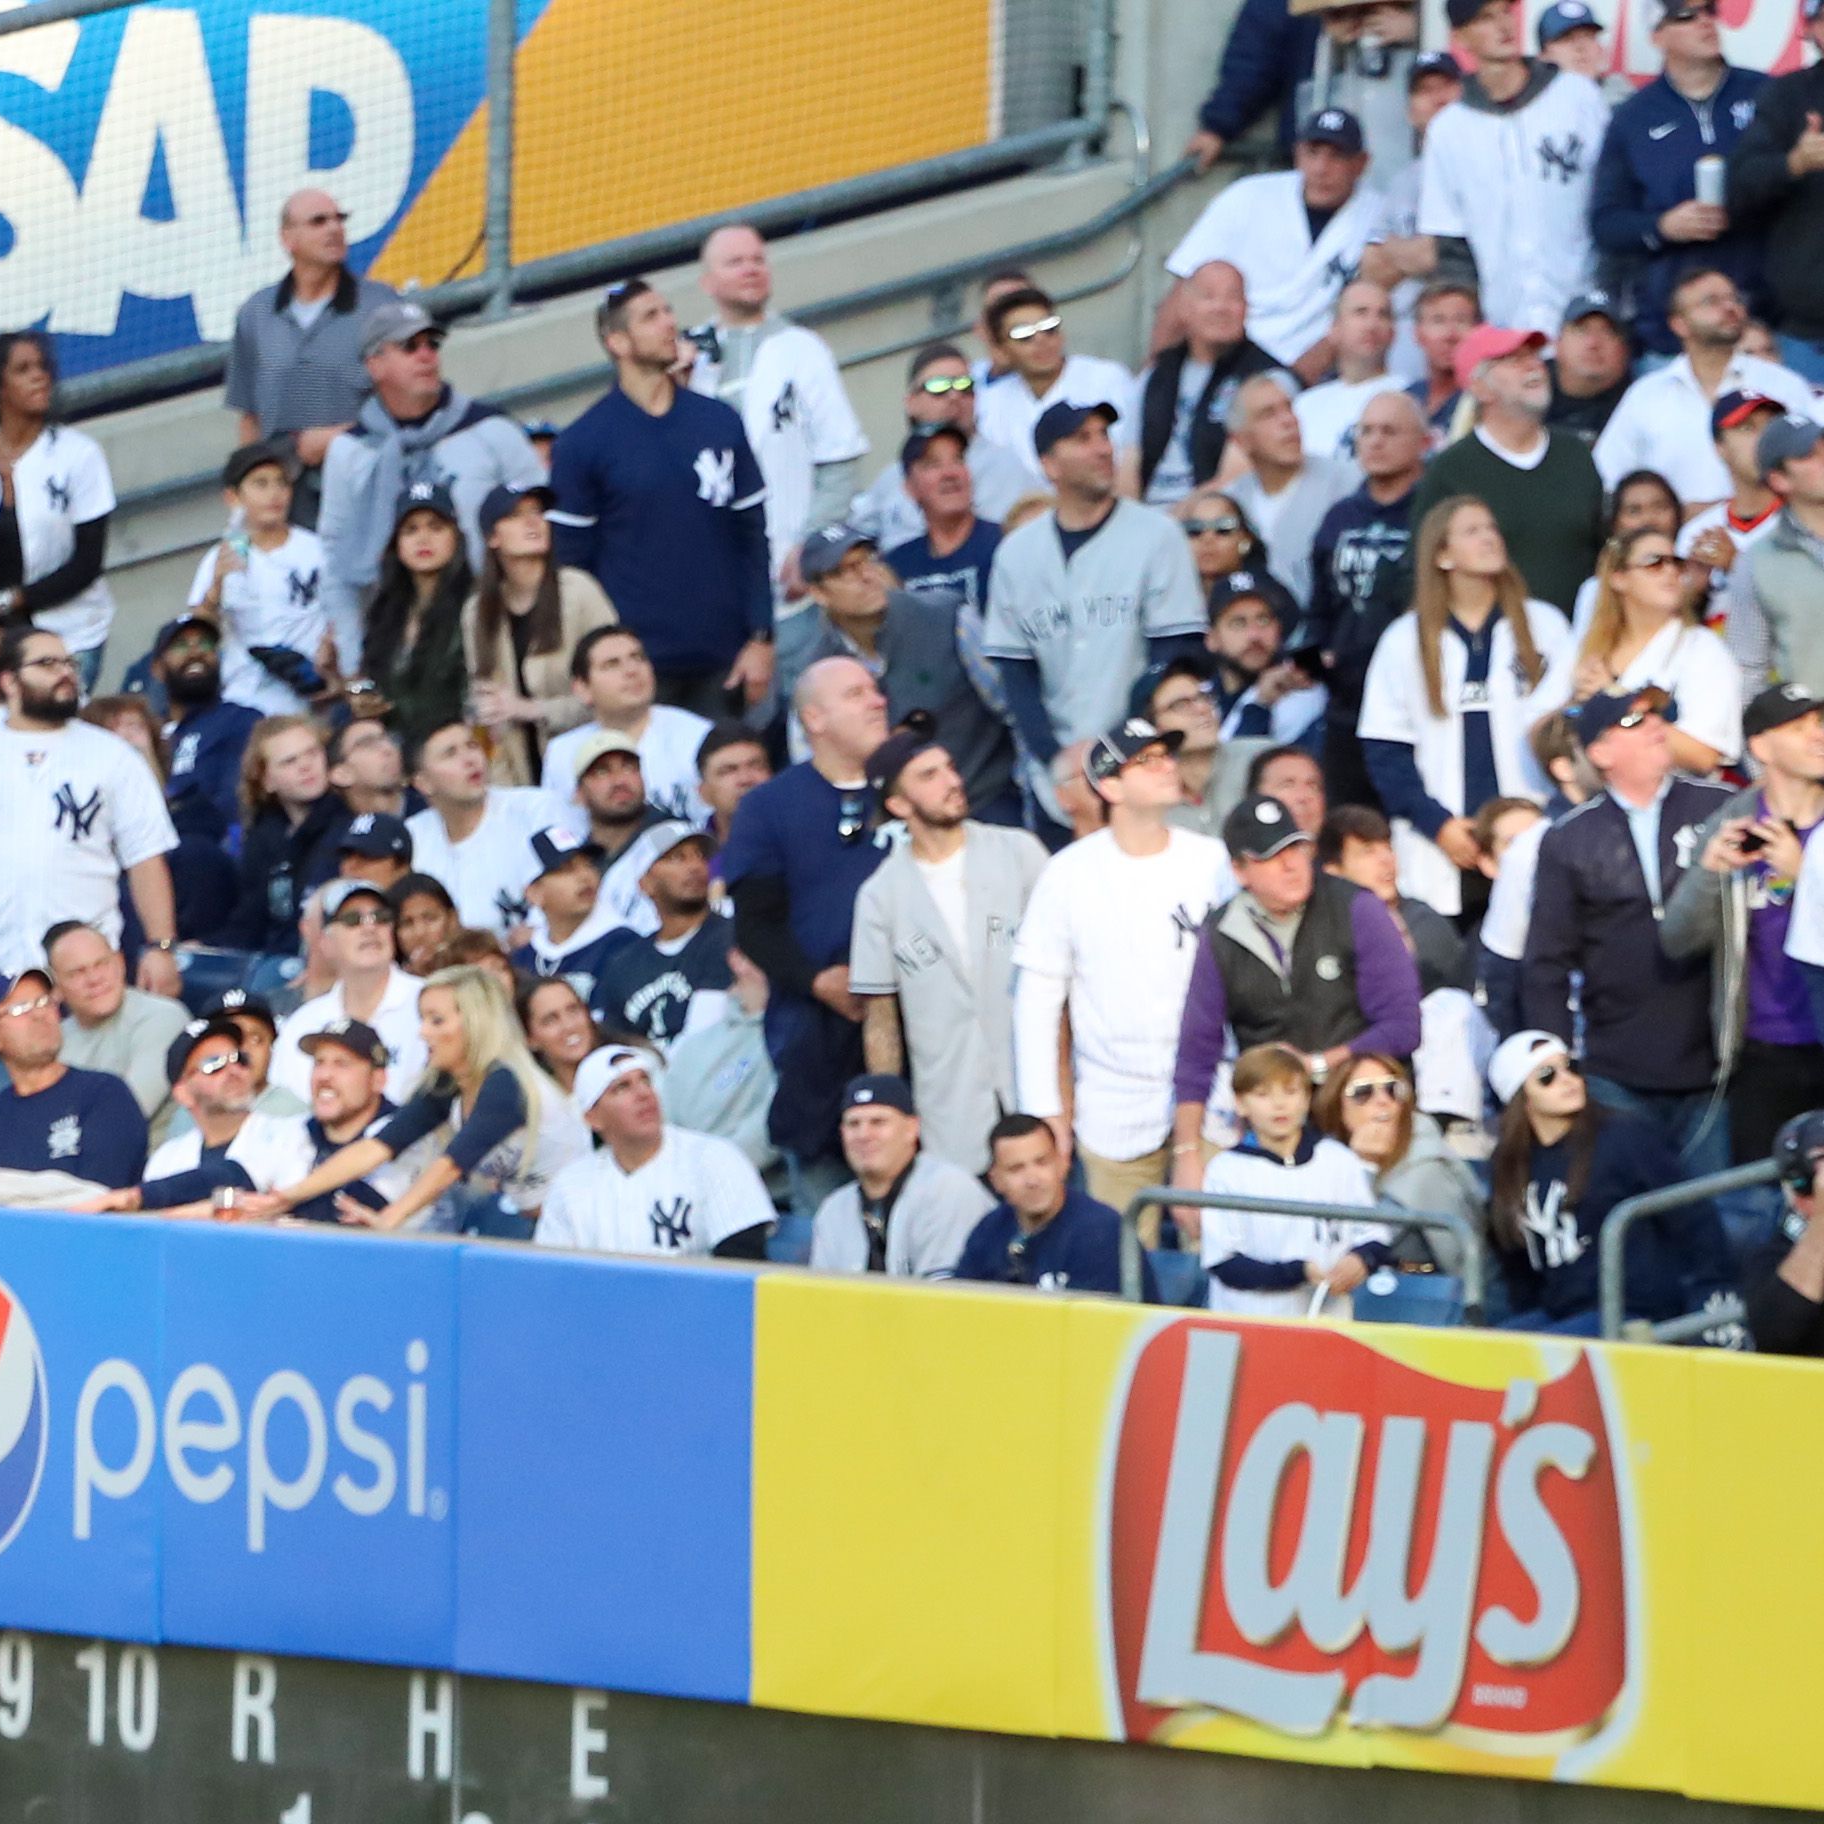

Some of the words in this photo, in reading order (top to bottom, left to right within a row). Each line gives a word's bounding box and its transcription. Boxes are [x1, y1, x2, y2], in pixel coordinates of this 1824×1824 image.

[73, 1339, 429, 1554] pepsi
[1136, 1329, 1597, 1737] Lay's
[76, 1643, 159, 1752] 10
[232, 1653, 275, 1764] R
[407, 1671, 453, 1780] H
[571, 1692, 609, 1799] E
